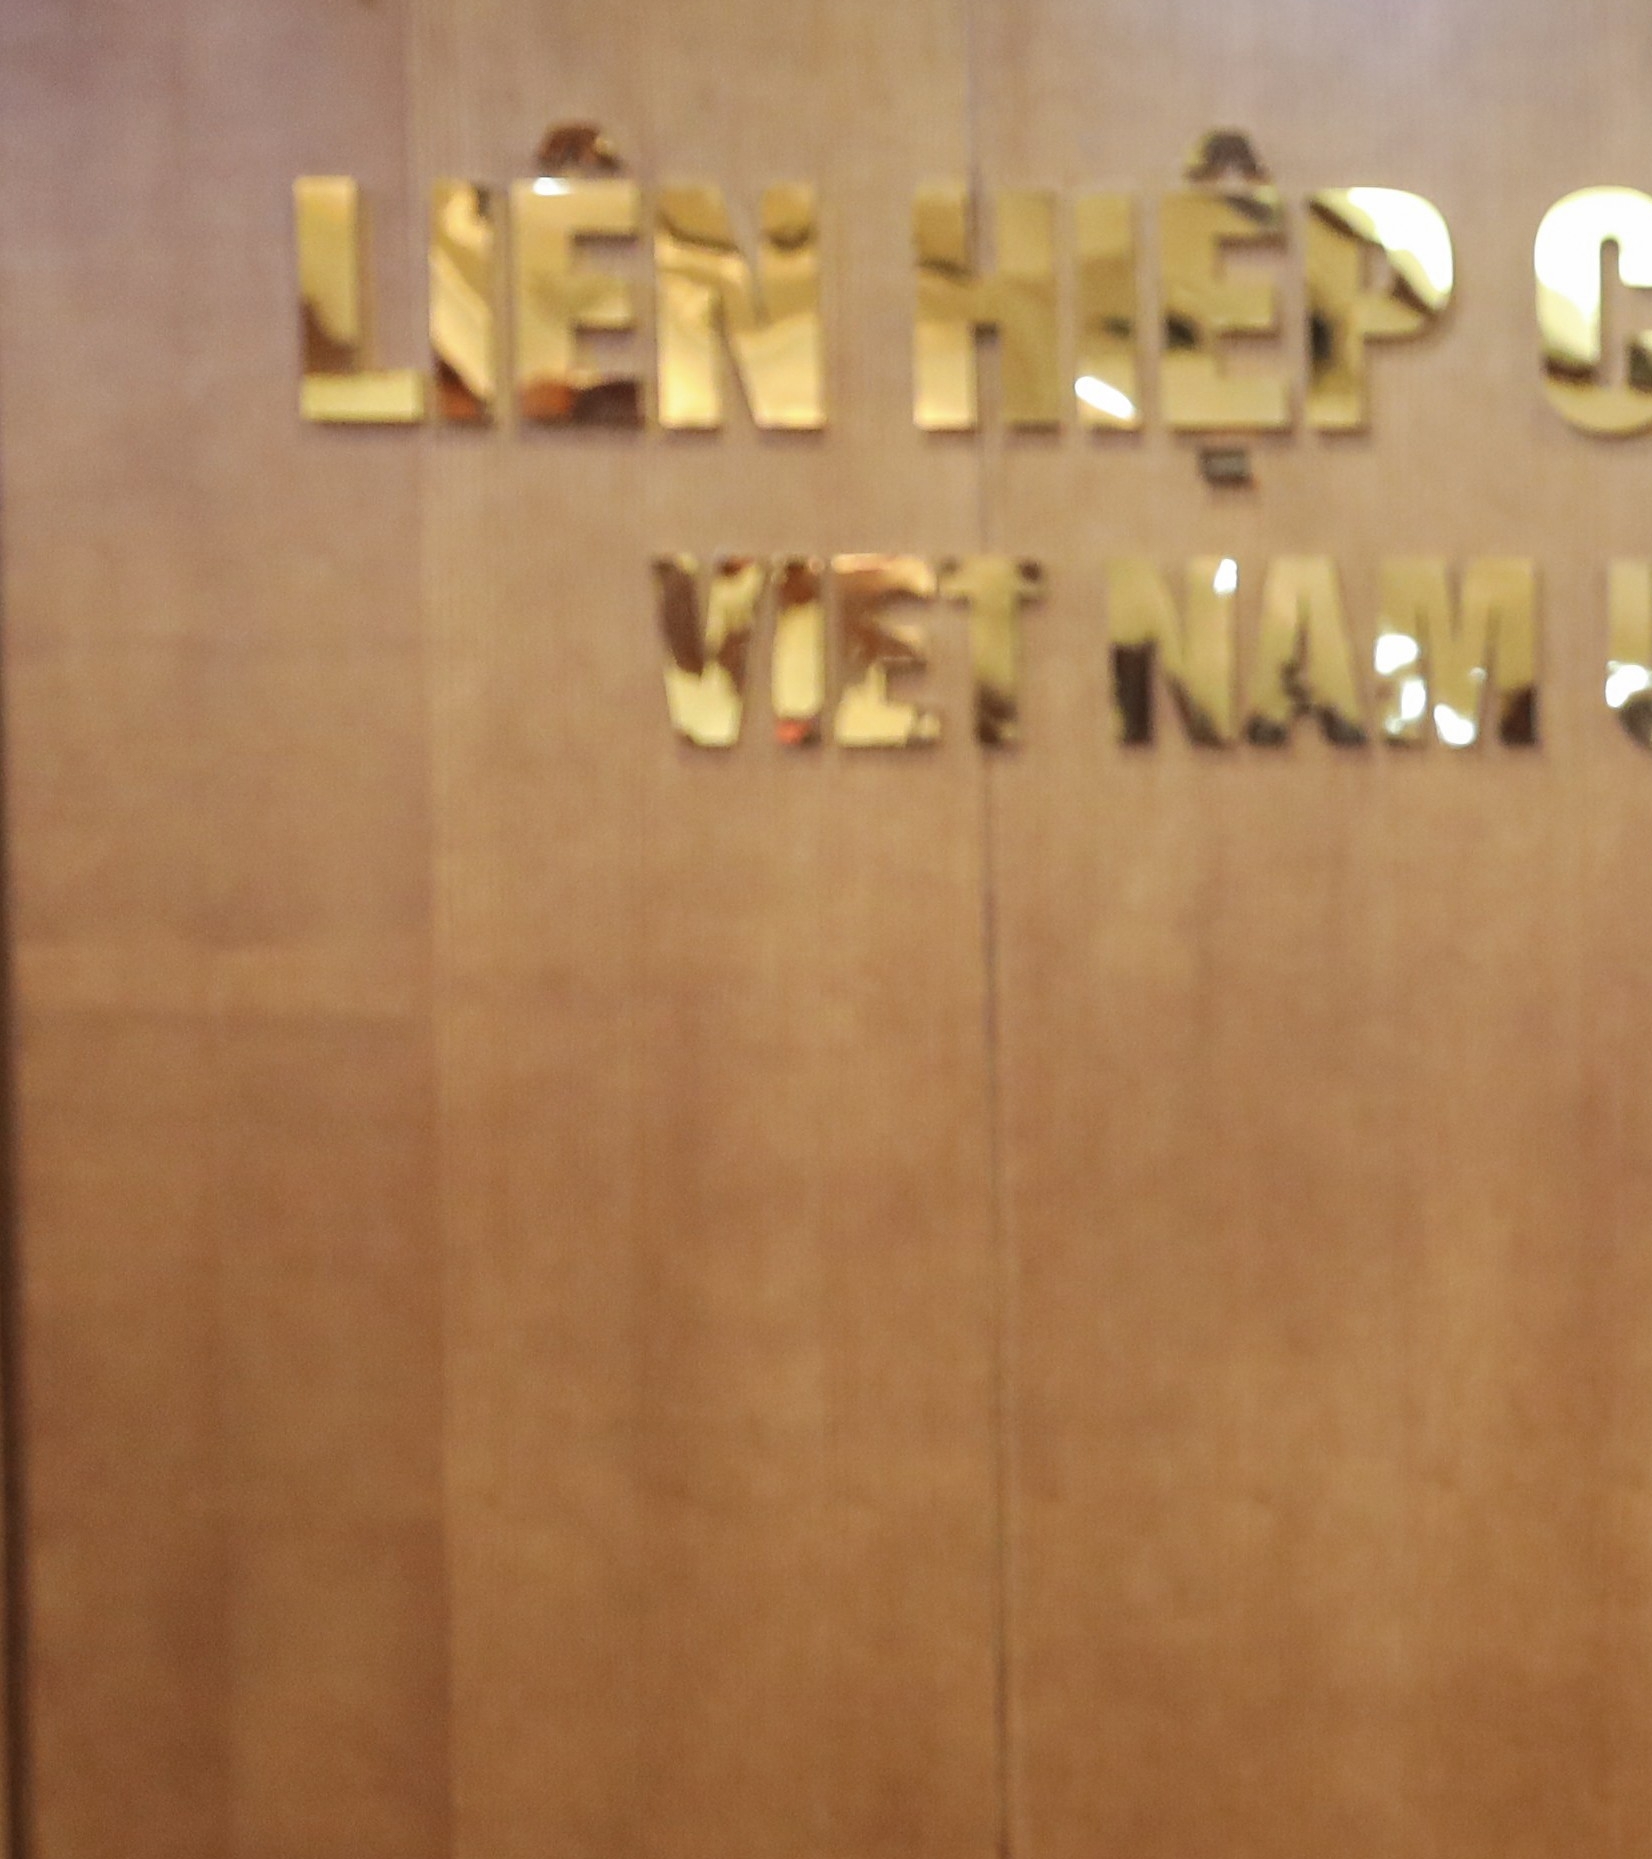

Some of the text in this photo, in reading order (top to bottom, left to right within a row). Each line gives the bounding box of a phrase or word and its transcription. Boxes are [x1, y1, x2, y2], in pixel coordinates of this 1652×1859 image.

[293, 123, 822, 430] LIÊN
[913, 127, 1454, 489] HIỆP
[652, 552, 1044, 750] VIET
[1106, 555, 1540, 750] NAM
